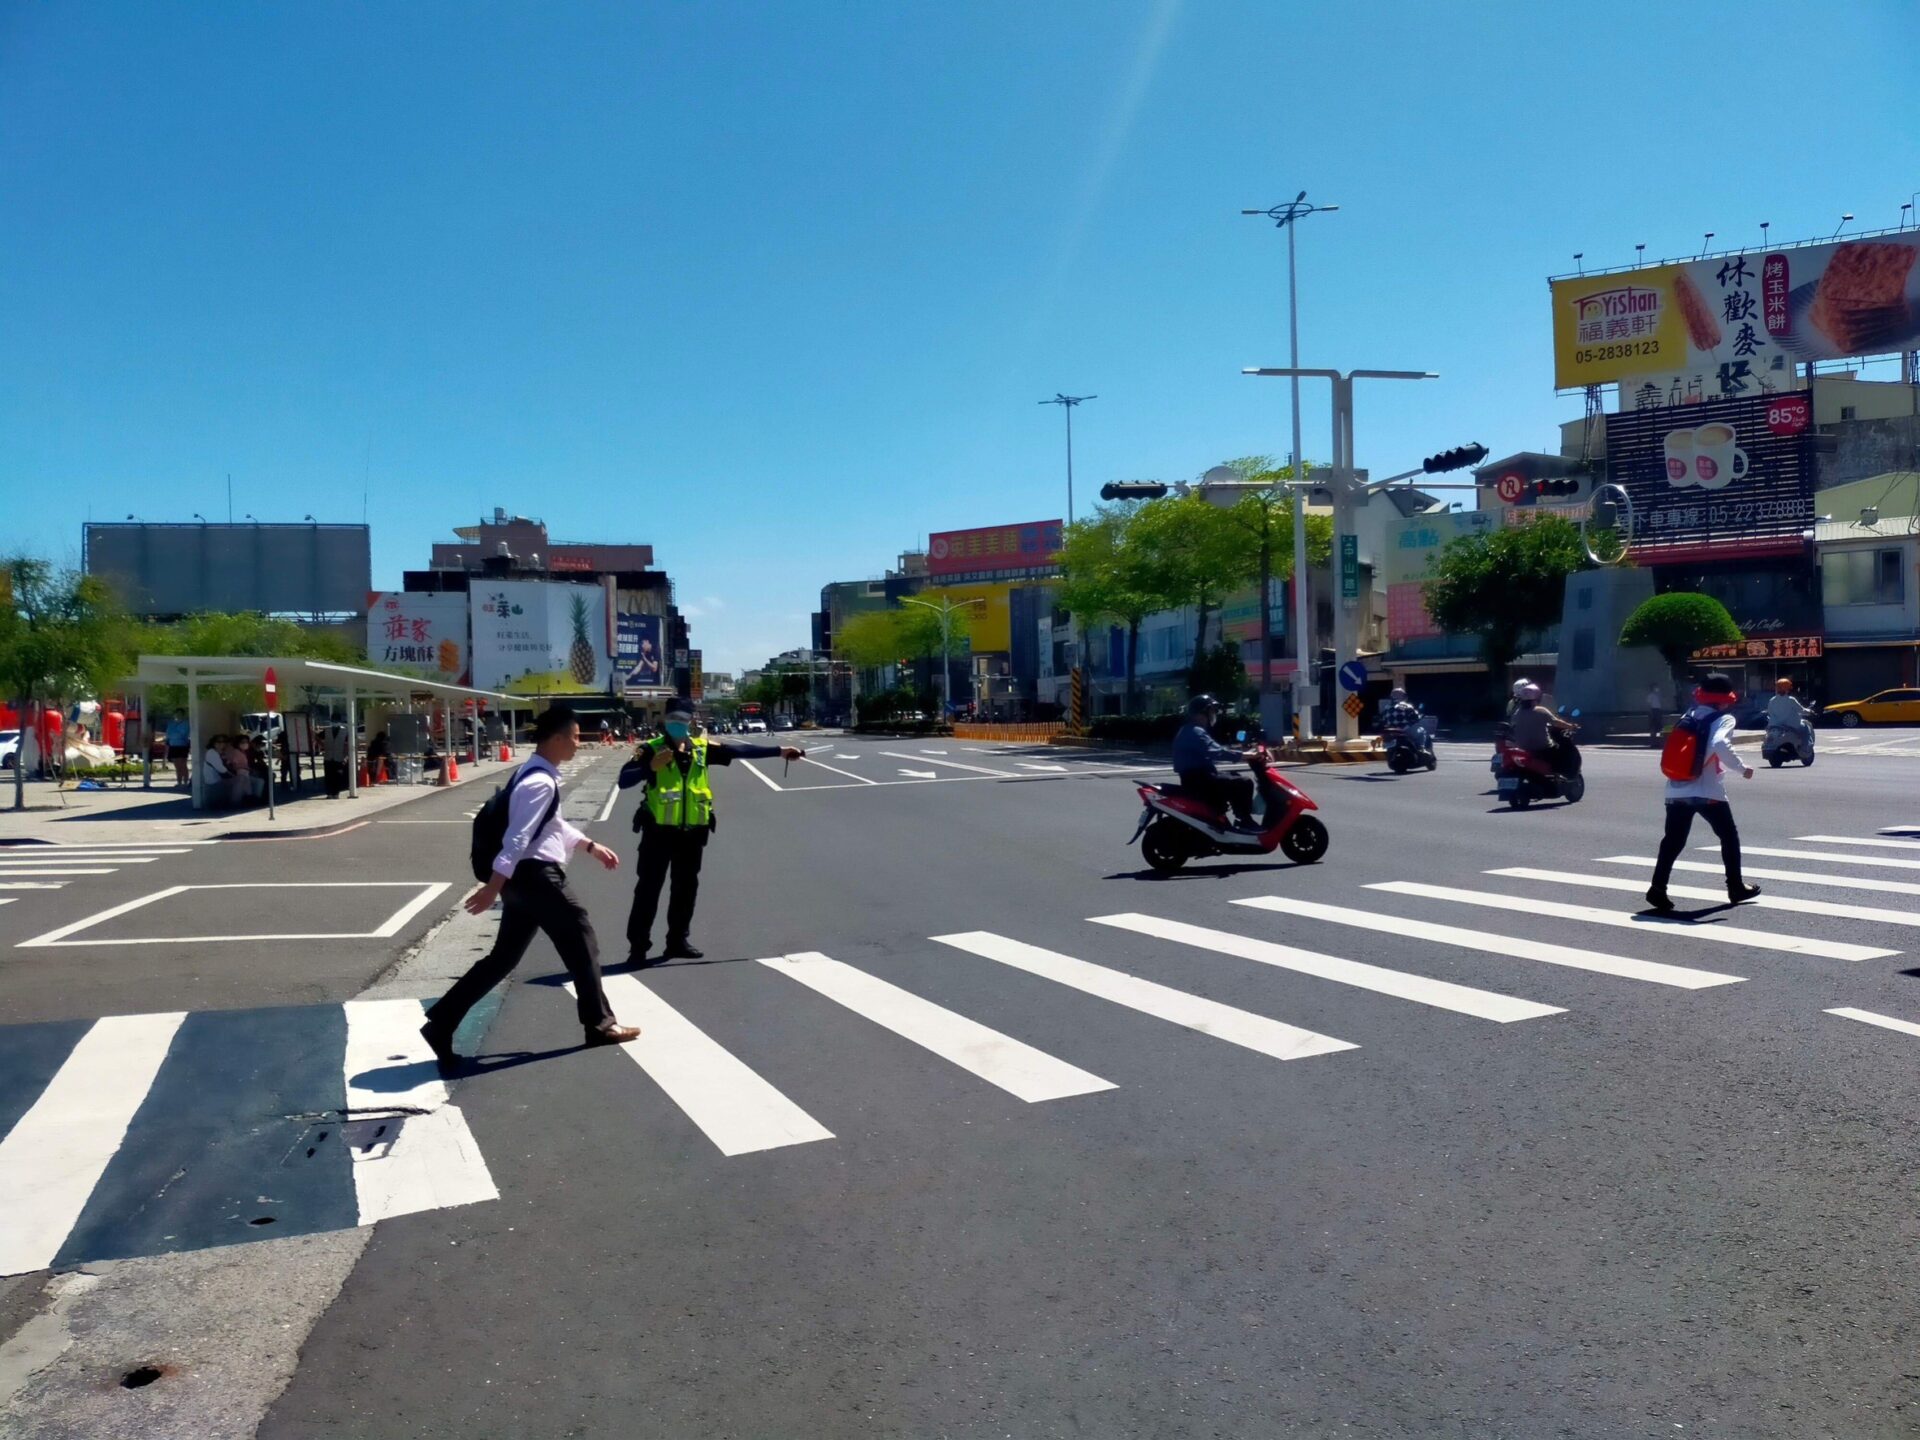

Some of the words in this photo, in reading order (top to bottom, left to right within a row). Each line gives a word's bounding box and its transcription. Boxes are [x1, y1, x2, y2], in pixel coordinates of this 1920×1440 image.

[1765, 262, 1786, 330] 烤玉米餅
[1579, 314, 1657, 343] 福義軒
[1576, 340, 1659, 364] 05-2838123
[1344, 545, 1355, 590] 中山路
[382, 614, 433, 643] 莊家
[383, 646, 434, 663] 方塊酥
